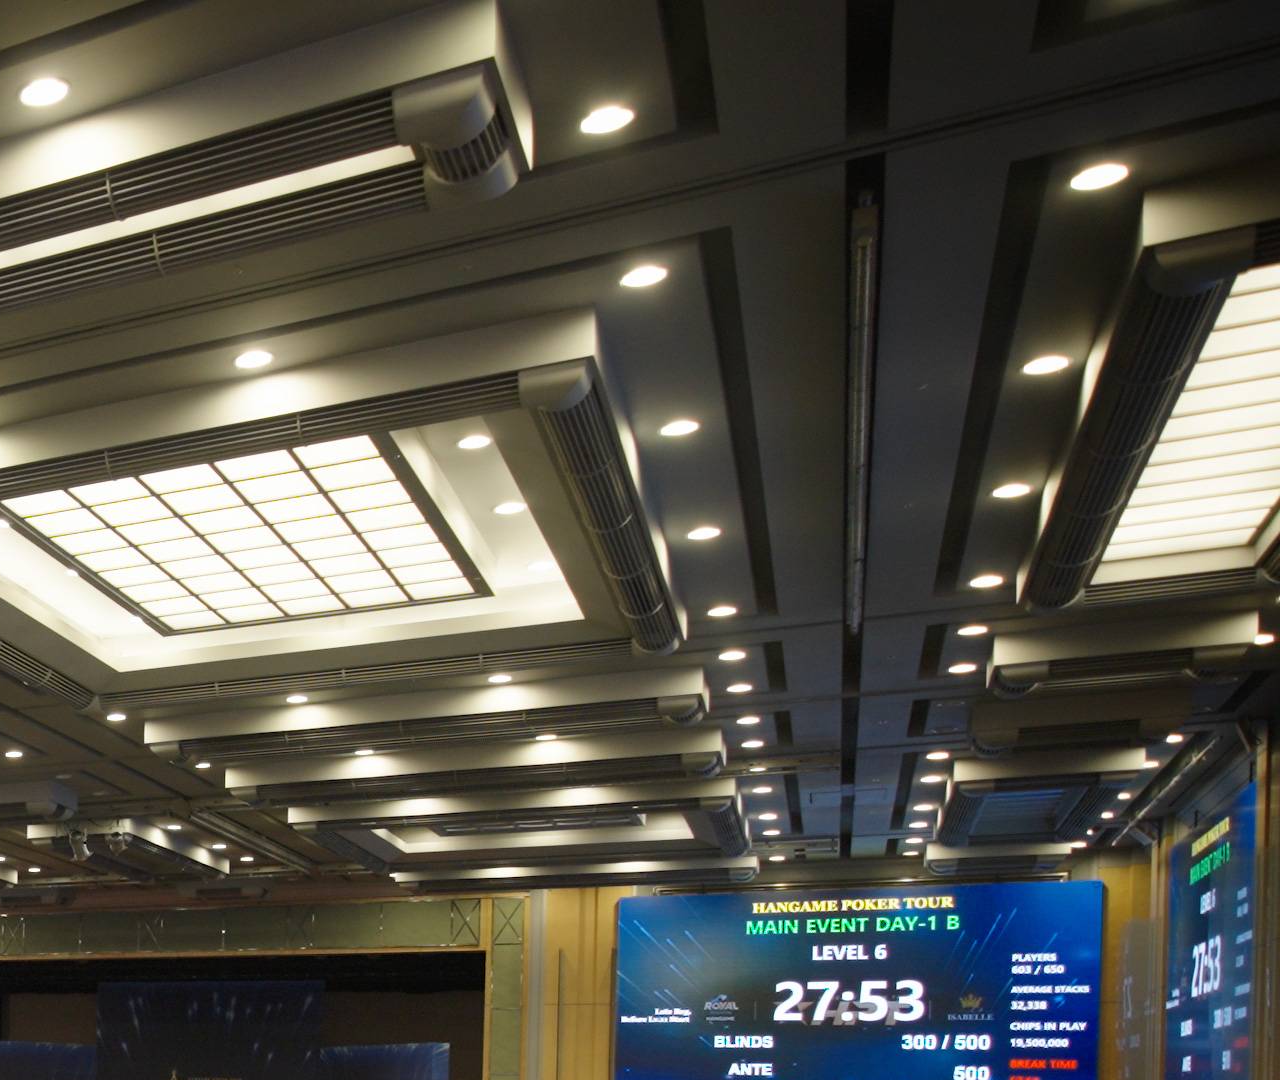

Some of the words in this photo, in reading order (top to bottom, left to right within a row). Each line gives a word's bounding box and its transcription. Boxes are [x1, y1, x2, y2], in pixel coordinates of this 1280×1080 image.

[752, 900, 837, 914] HANGAME
[841, 898, 899, 911] POKER
[903, 896, 953, 909] TOUR
[746, 919, 798, 935] MAIN
[807, 917, 869, 933] EVENT
[876, 916, 937, 932] DAY-1
[947, 915, 960, 930] B
[812, 945, 868, 961] LEVEL
[874, 944, 887, 960] 6
[1011, 953, 1057, 962] PLAYERS
[1043, 965, 1065, 974] 650
[1191, 935, 1222, 998] 27:53
[1011, 985, 1053, 994] AVERAGE
[1054, 985, 1090, 993] STACKS
[704, 1001, 739, 1011] ROYAL
[773, 980, 926, 1022] 27:53
[947, 1013, 994, 1021] ISABELLE
[1010, 1022, 1041, 1031] CHIPS
[1044, 1022, 1057, 1031] IN
[1059, 1022, 1087, 1031] PLAY
[714, 1035, 774, 1049] BLINDS
[901, 1034, 937, 1050] 300
[941, 1034, 950, 1050] /
[954, 1034, 991, 1050] 500
[728, 1063, 773, 1076] ANTE
[1009, 1059, 1046, 1069] BREAK
[1050, 1059, 1077, 1069] TIME
[953, 1066, 991, 1080] 500
